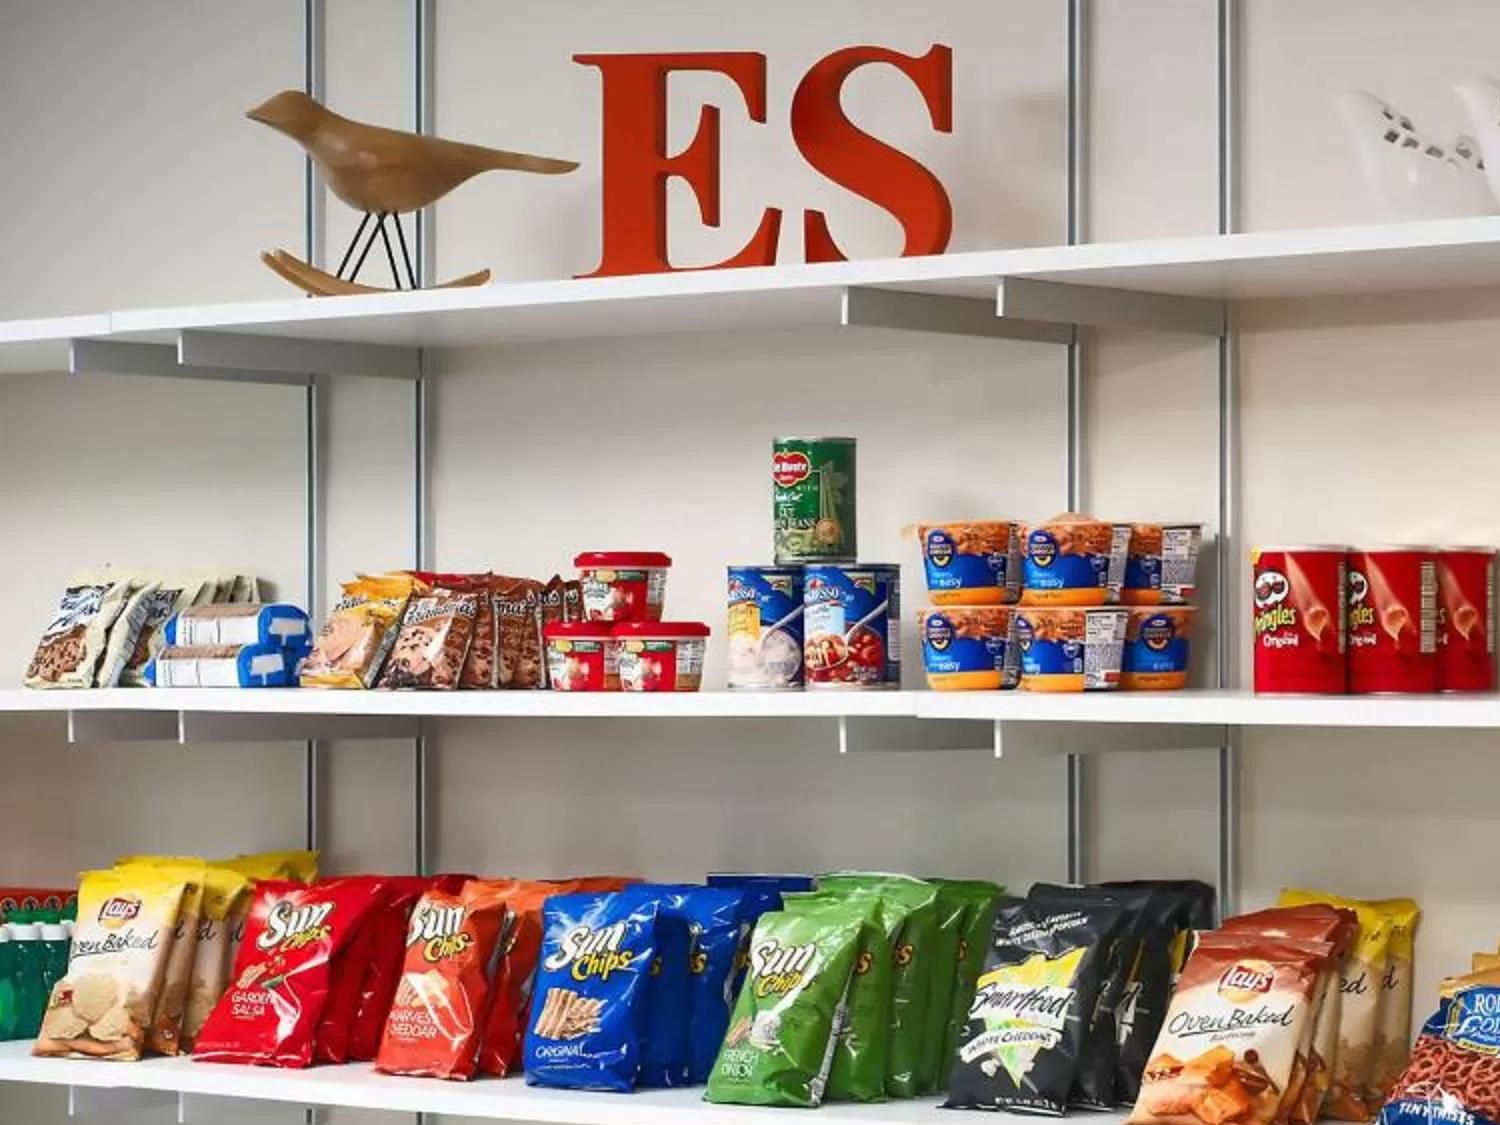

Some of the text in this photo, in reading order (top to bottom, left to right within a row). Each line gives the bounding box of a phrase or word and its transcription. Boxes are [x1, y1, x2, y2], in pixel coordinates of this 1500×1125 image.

[572, 44, 953, 279] ES
[571, 949, 634, 982] Chips
[1220, 965, 1275, 994] Lay's
[1168, 1004, 1295, 1035] Oven Baked
